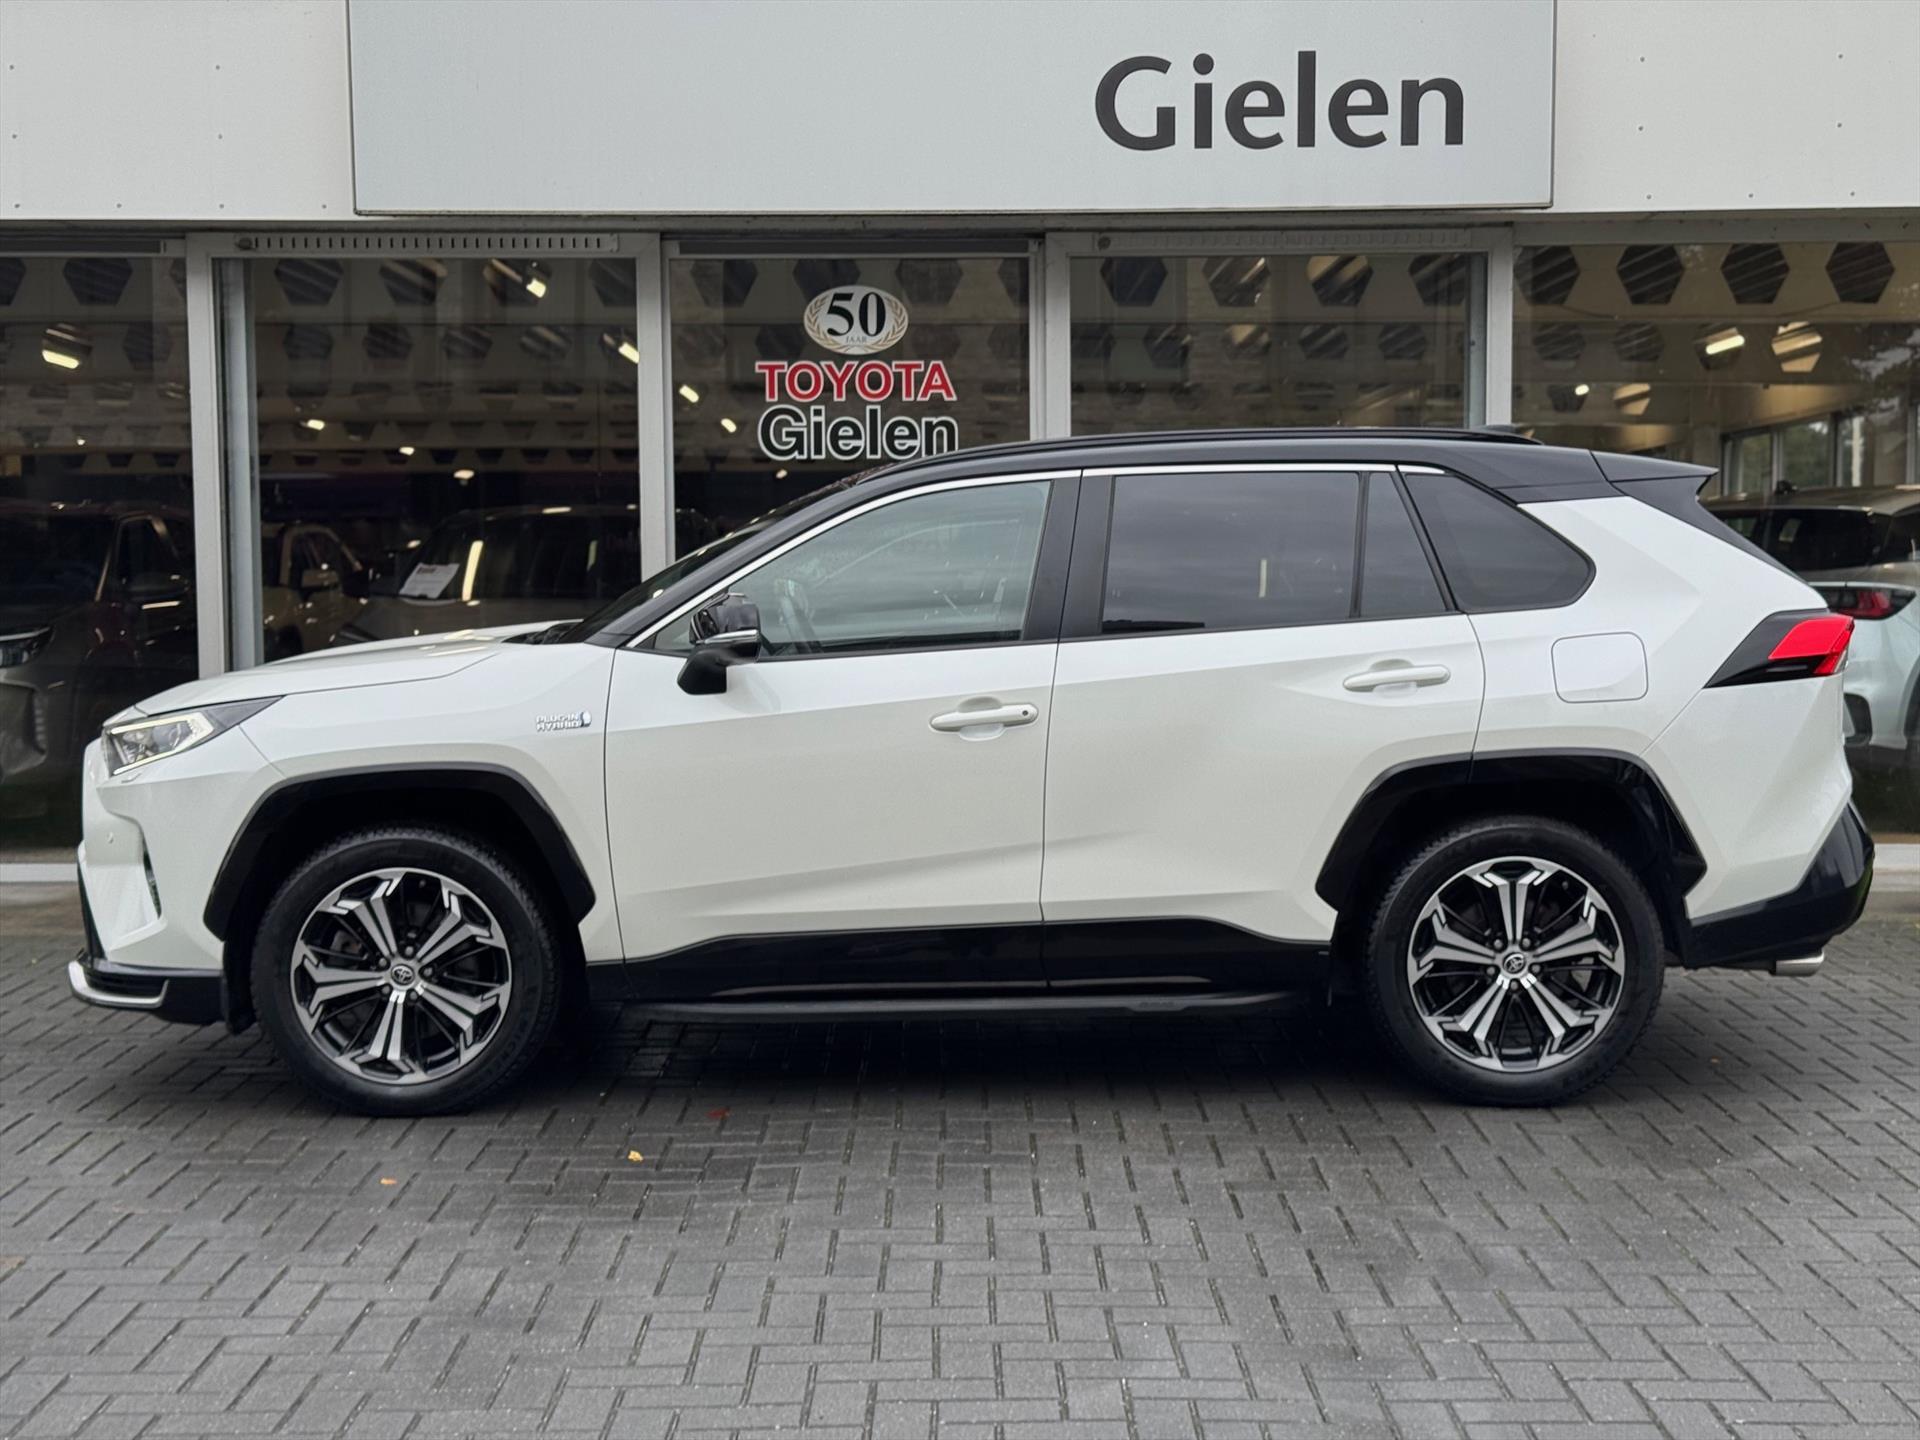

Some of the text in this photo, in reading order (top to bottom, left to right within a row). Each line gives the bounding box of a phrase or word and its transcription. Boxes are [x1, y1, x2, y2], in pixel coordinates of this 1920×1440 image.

[1095, 50, 1464, 151] Gielen
[826, 292, 886, 337] 50
[755, 360, 957, 402] TOYOTA
[758, 404, 959, 461] Gielen
